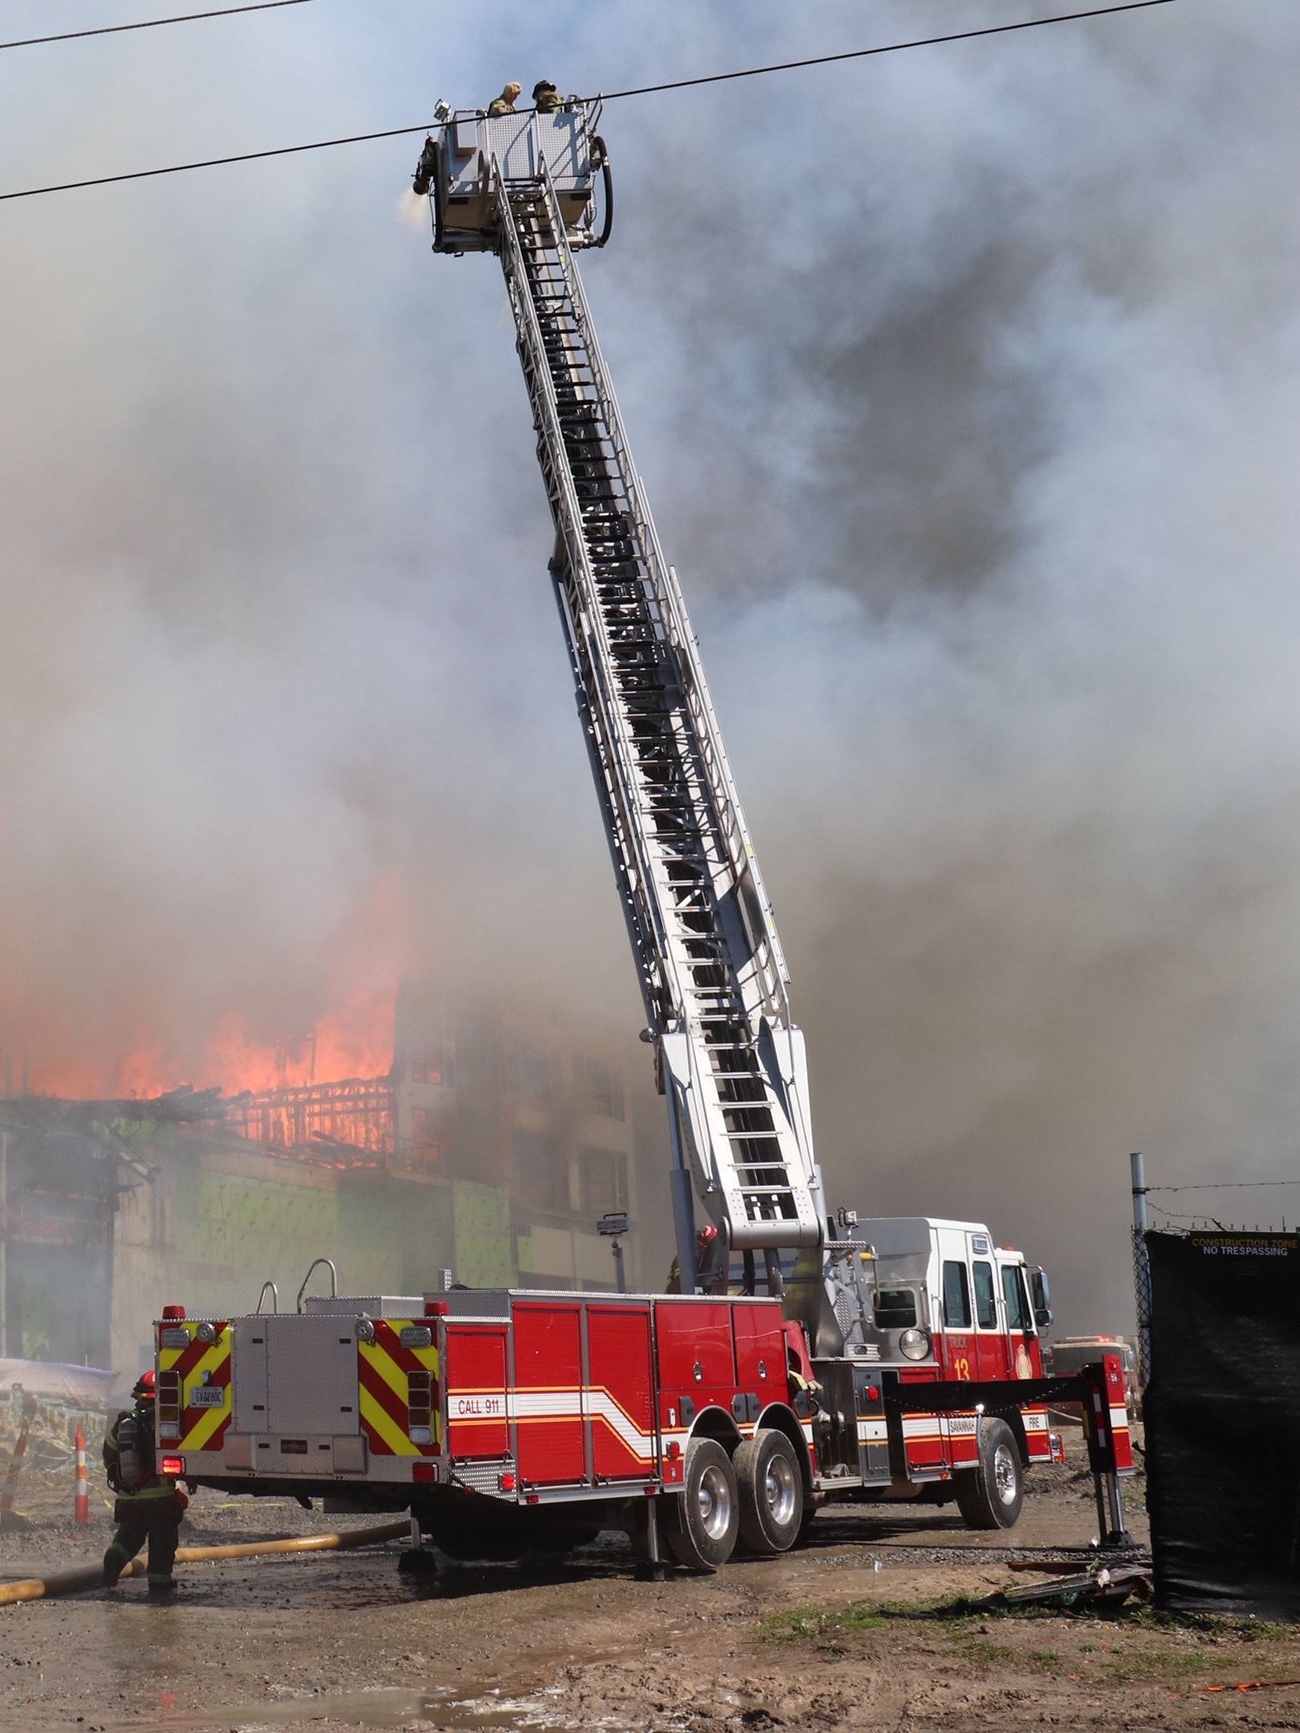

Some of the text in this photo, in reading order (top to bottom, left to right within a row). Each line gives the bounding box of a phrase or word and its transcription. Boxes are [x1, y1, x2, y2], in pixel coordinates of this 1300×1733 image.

[1191, 1238, 1298, 1248] CONSTRUCTION ZONE
[1203, 1246, 1289, 1256] NO TRESPASSING
[954, 1358, 971, 1381] 13
[459, 1399, 499, 1415] CALL 911
[1028, 1416, 1040, 1428] FIRE
